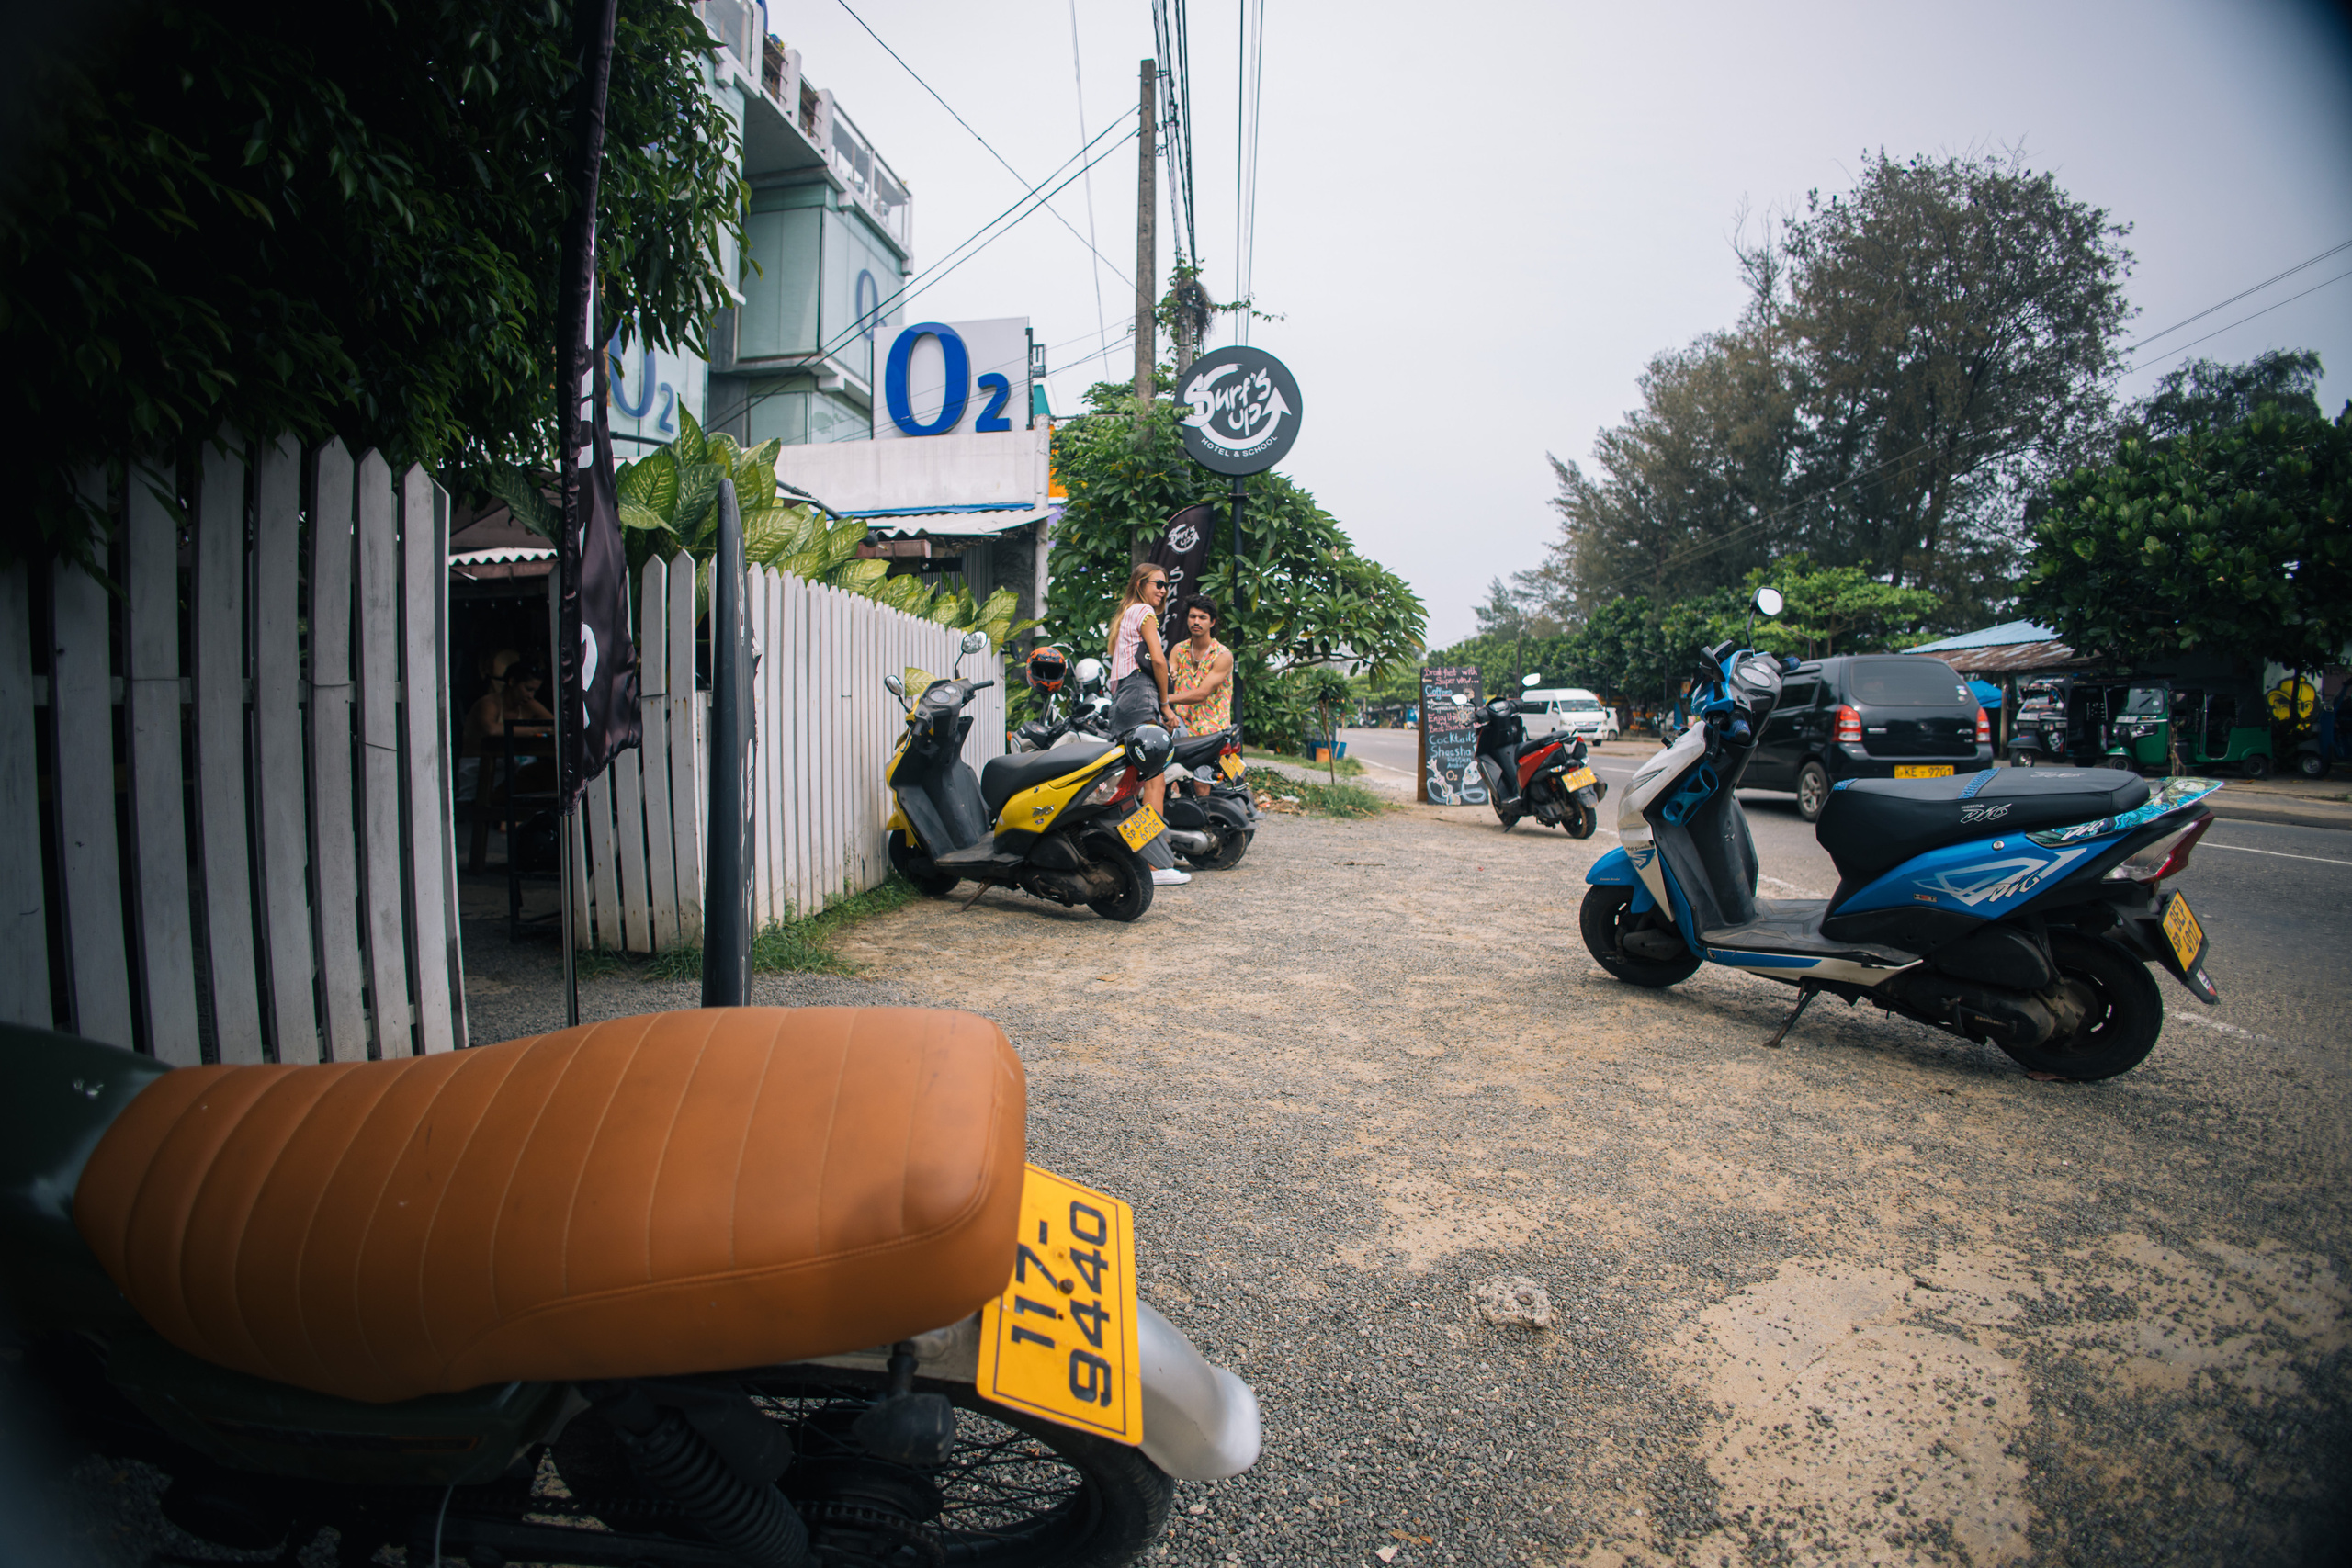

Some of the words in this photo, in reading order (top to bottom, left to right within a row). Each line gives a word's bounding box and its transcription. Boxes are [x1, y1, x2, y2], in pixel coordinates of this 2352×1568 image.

[1200, 436, 1230, 457] HOTEL
[1241, 434, 1279, 457] SCHOOL
[1462, 665, 1478, 676] with
[1435, 677, 1455, 689] Super
[1427, 713, 1447, 725] Enjoy
[1429, 731, 1476, 745] Cocktails
[1905, 766, 1917, 777] KE
[1131, 808, 1151, 829] BBY
[1126, 829, 1136, 841] SP
[1140, 818, 1161, 841] 6905
[2169, 899, 2187, 932] BEP
[2172, 931, 2183, 953] SP
[1069, 1200, 1112, 1408] 9440
